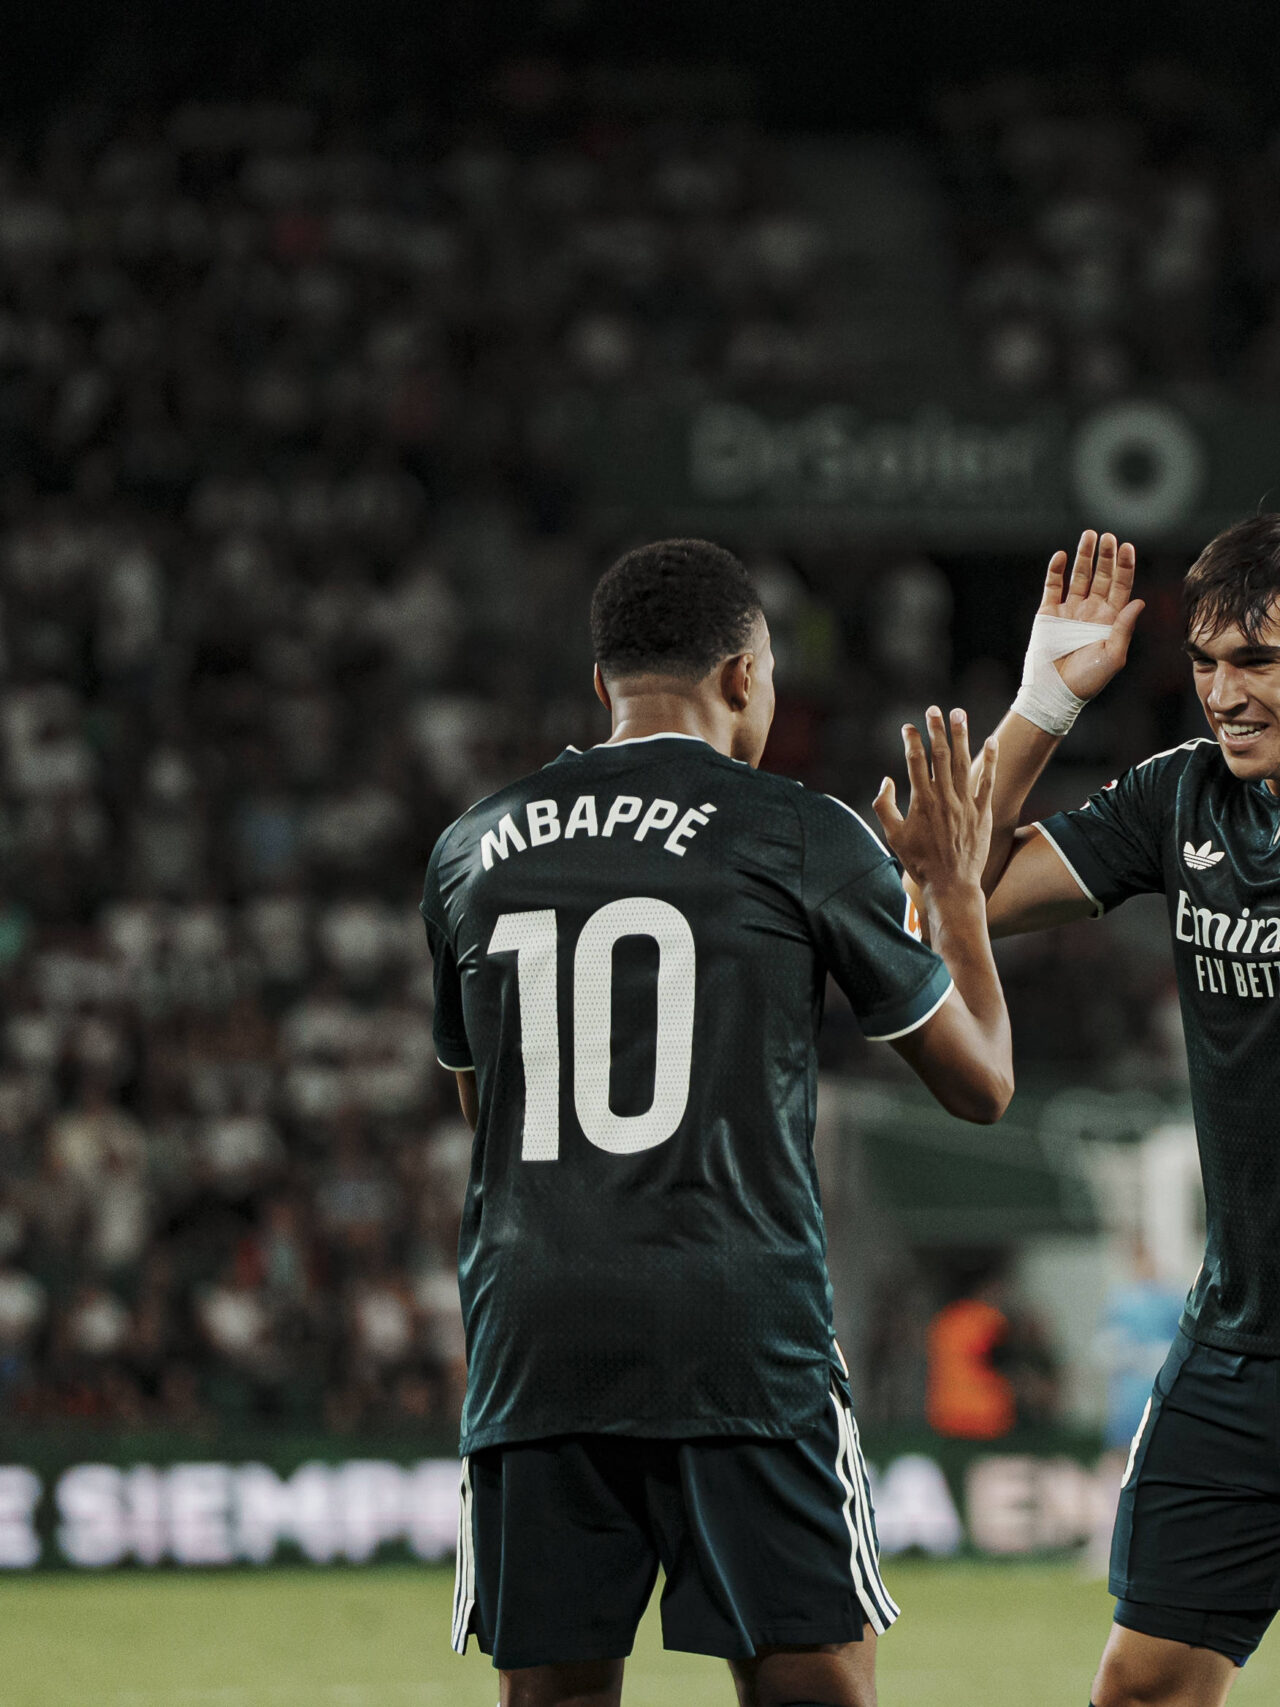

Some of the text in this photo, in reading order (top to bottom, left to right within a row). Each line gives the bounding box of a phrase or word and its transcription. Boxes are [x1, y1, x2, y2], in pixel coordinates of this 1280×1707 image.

[480, 795, 717, 871] MBAPPÉ
[1195, 954, 1227, 994] FLY
[487, 897, 695, 1162] 10
